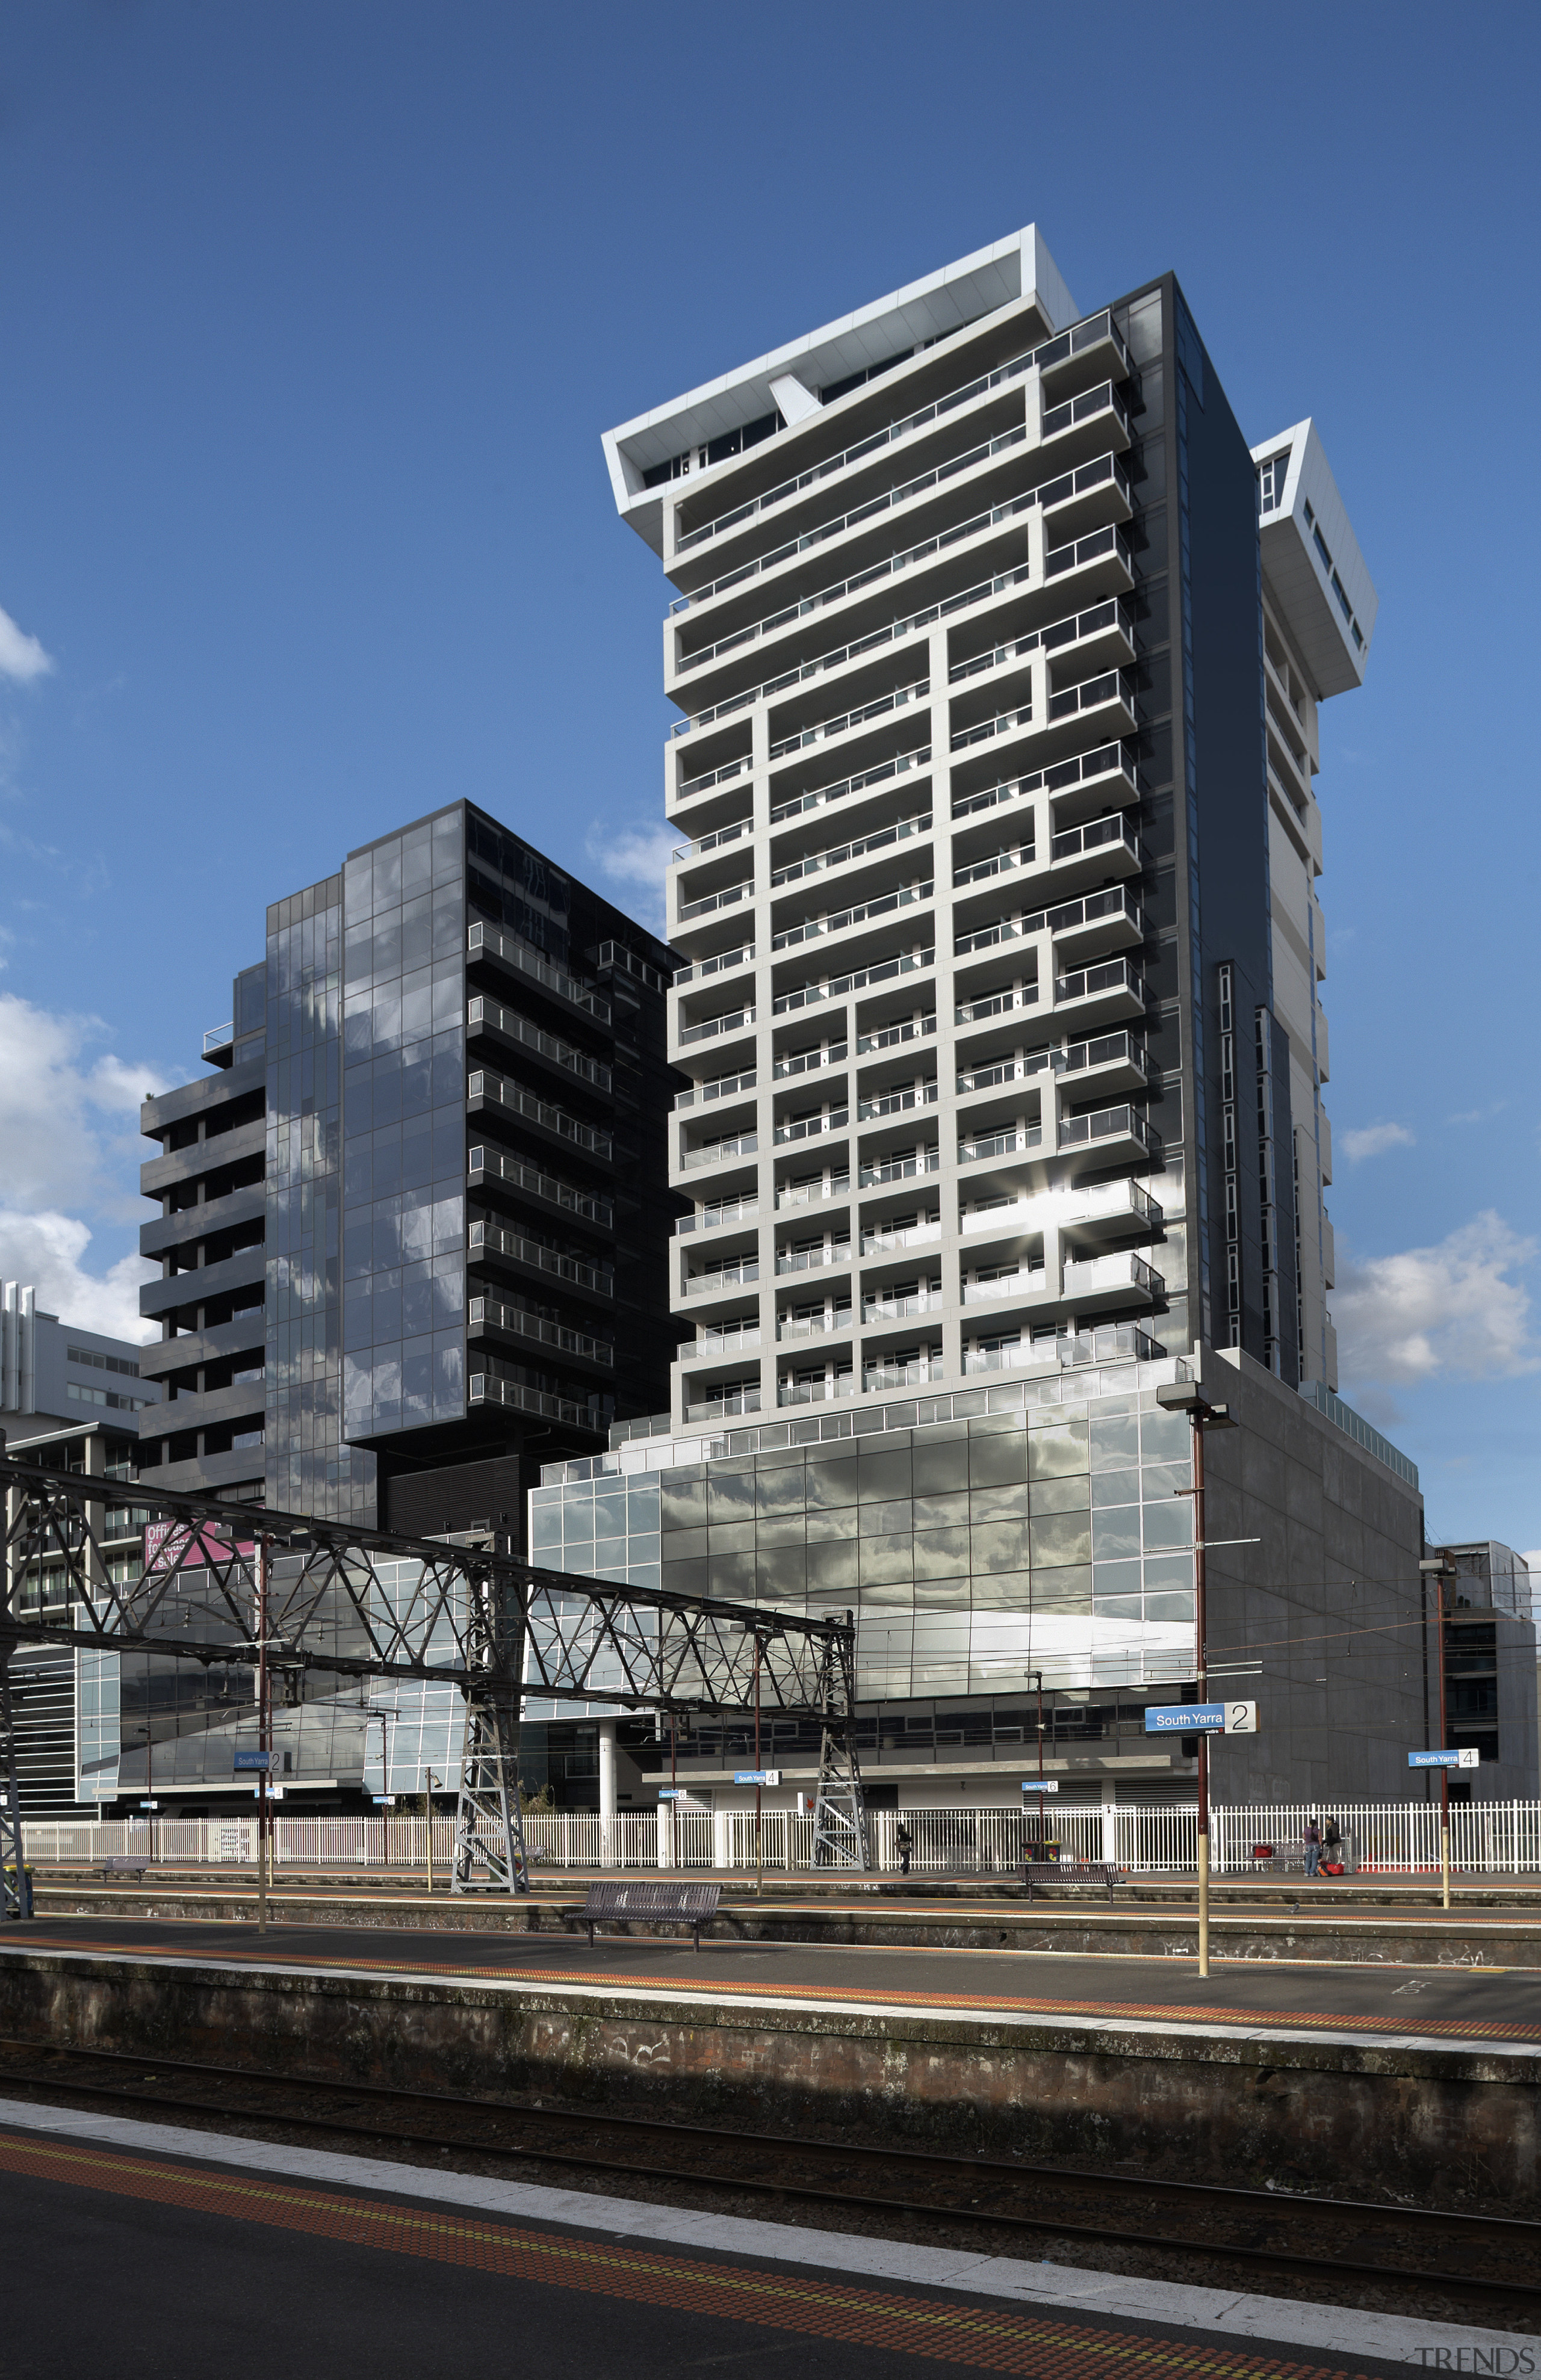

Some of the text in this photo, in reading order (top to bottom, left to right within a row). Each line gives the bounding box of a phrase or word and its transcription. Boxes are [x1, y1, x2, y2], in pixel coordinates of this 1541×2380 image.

[148, 1524, 184, 1540] Offies
[164, 1538, 189, 1552] eas
[1156, 1705, 1248, 1730] South Yarra 2
[272, 1753, 279, 1770] 2
[1415, 1755, 1437, 1764] South
[1463, 1751, 1473, 1765] 4
[769, 1772, 774, 1784] 4
[276, 1788, 281, 1798] 4
[1050, 1782, 1056, 1791] 6
